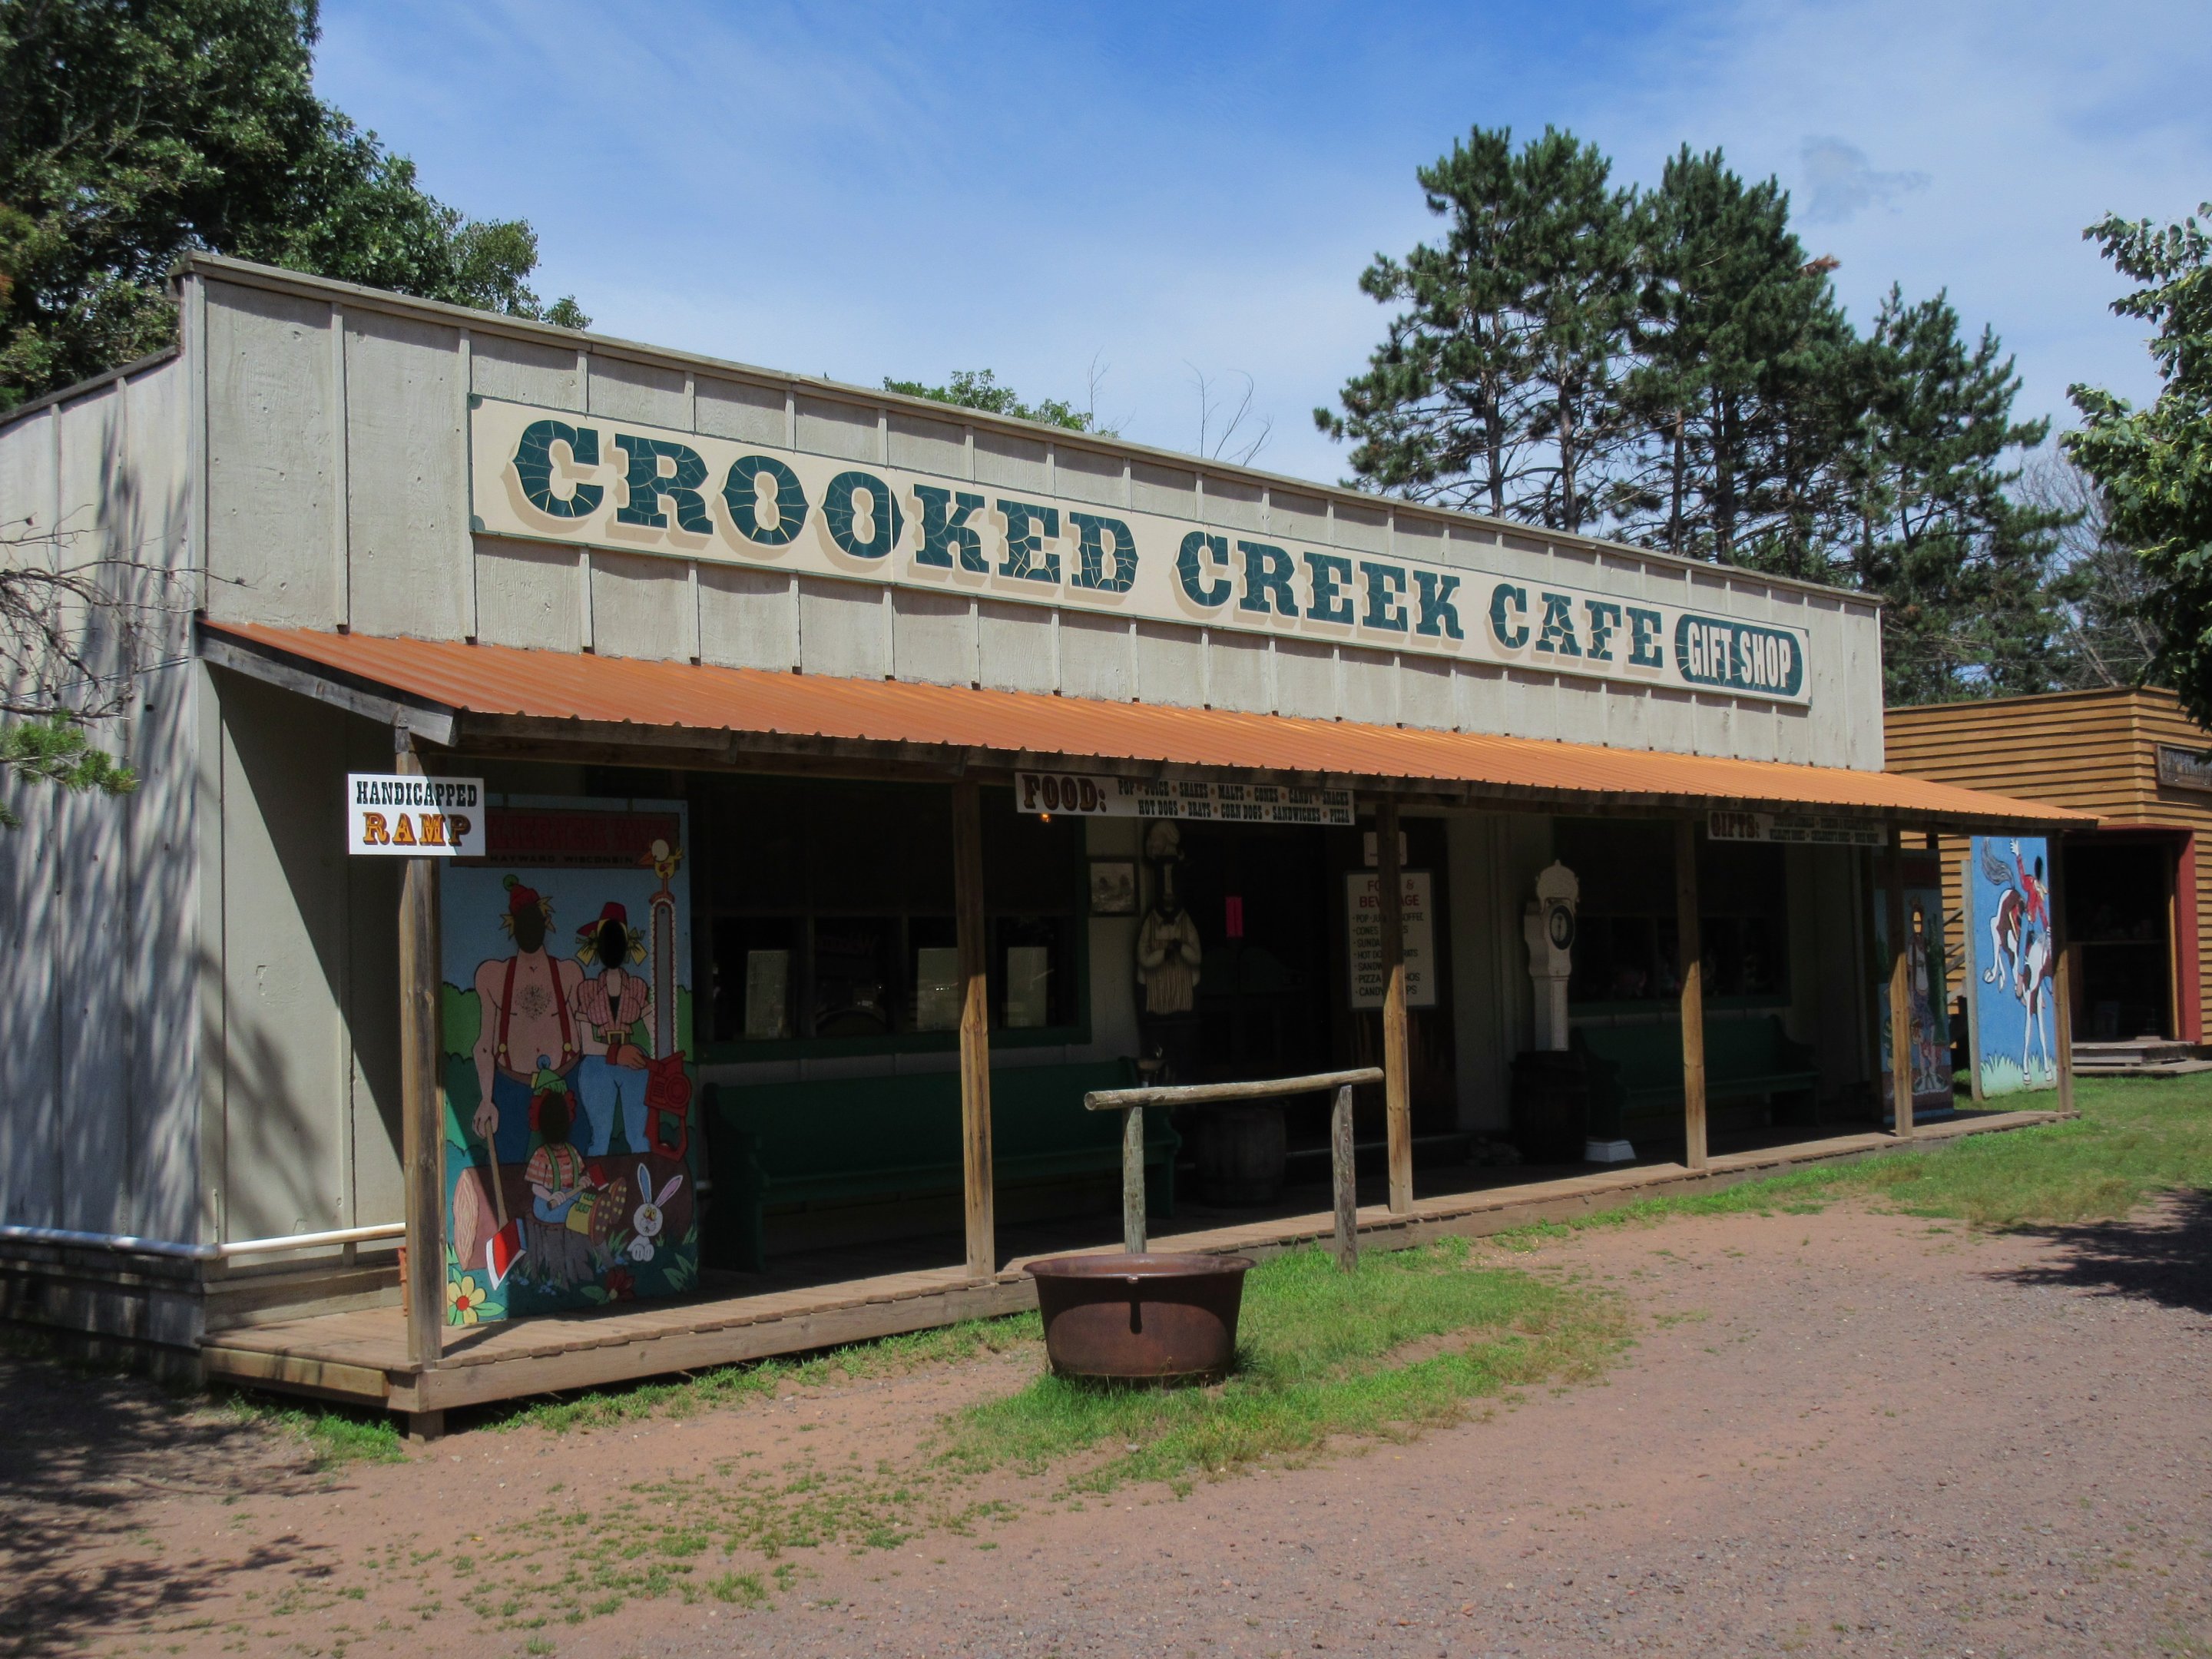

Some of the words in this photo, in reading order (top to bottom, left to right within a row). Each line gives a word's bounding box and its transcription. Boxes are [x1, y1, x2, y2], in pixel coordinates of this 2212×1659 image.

[507, 419, 1140, 599] CROOKED
[1173, 530, 1465, 641] CREEK
[1488, 583, 1664, 669] CAFE
[1687, 621, 1734, 682] GIFT
[1740, 630, 1793, 689] SHOP
[356, 781, 477, 806] HANDICAPPED
[1022, 774, 1107, 813] FOOD:
[1118, 780, 1134, 795] POP
[1179, 782, 1208, 799] SHAKES
[1217, 784, 1243, 800] MALTS
[1254, 786, 1278, 803] CONES
[1289, 788, 1313, 804] CANDY
[1323, 790, 1349, 806] SNACKS
[1137, 800, 1155, 815] HOT
[1157, 800, 1178, 816] DOGS
[1187, 801, 1211, 817] BRATS
[1220, 803, 1240, 819] CORN
[1243, 804, 1262, 820] DOGS
[1272, 806, 1320, 822] SANDWICHES
[1330, 809, 1349, 823] PIZZA
[363, 812, 472, 846] RAMP
[490, 854, 555, 863] HAYWARD
[564, 855, 634, 865] WISCONSIN
[1406, 879, 1414, 890] &
[1356, 914, 1368, 922] POP
[1356, 926, 1379, 935] CONES
[1357, 939, 1381, 947] SUNDA
[1358, 951, 1370, 959] HOT
[1359, 975, 1381, 983] PIZZA
